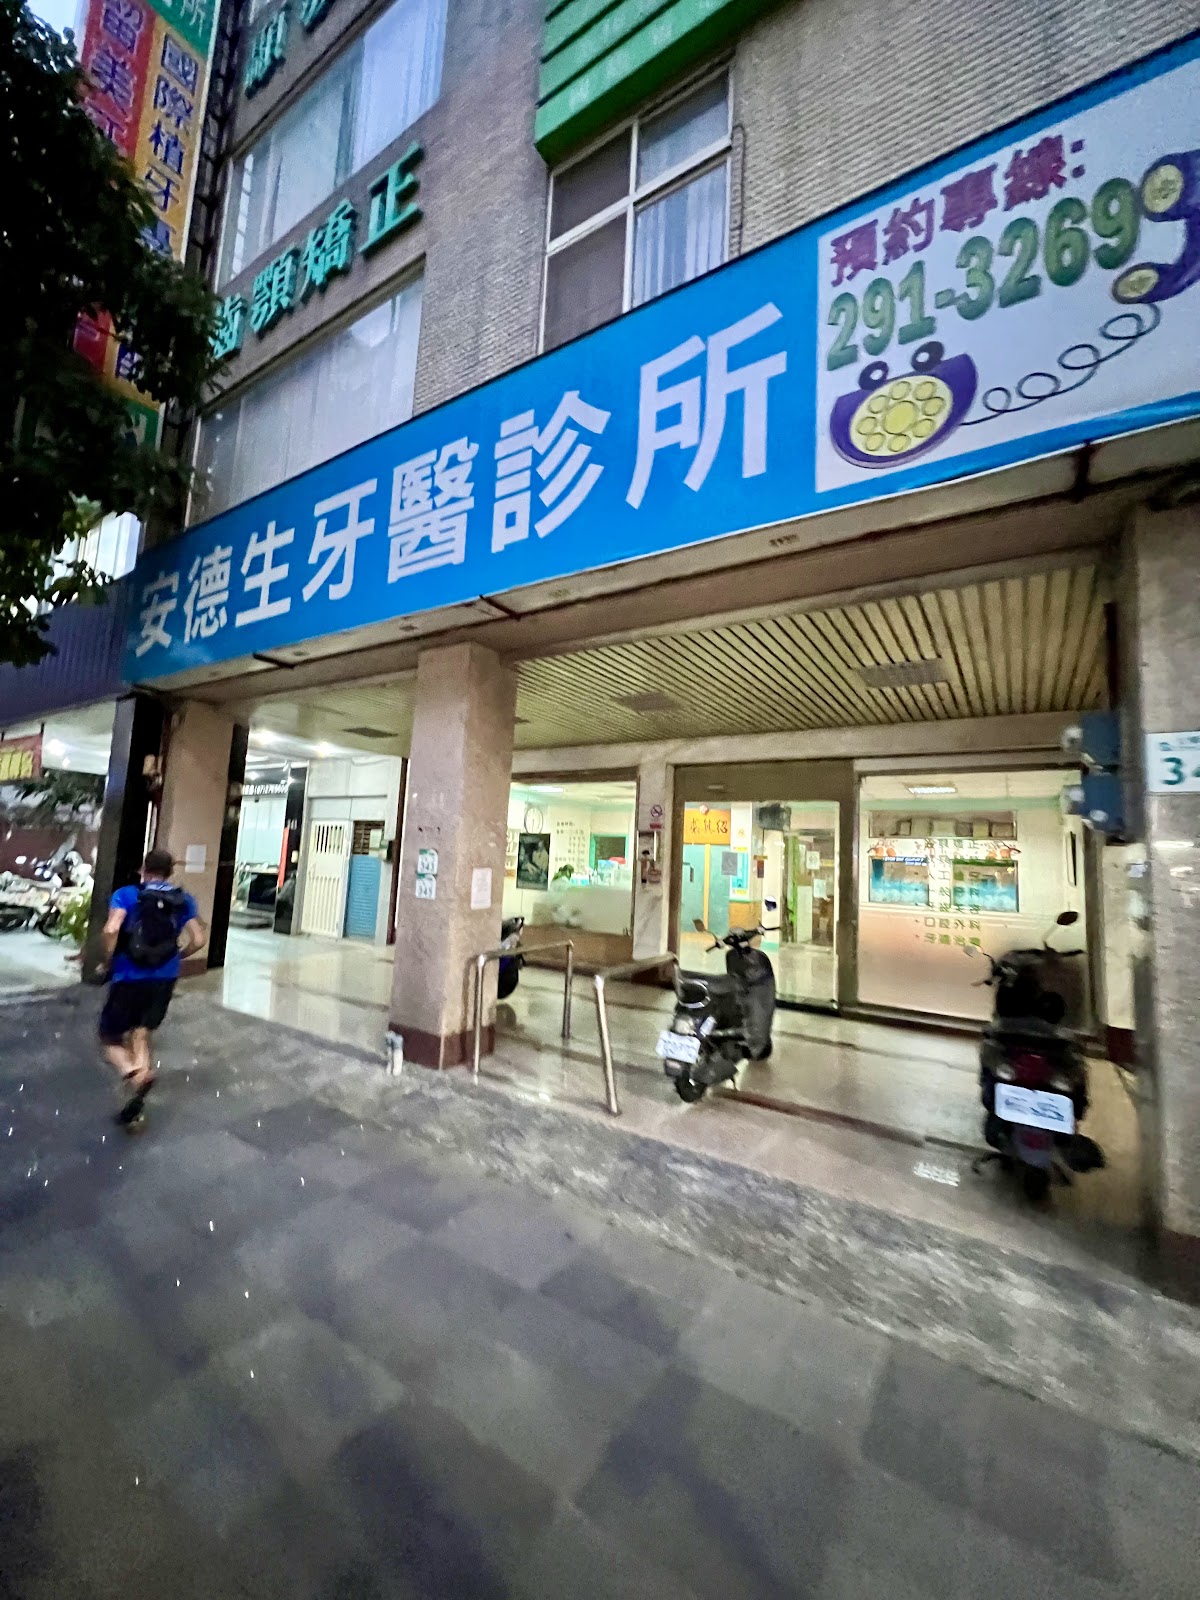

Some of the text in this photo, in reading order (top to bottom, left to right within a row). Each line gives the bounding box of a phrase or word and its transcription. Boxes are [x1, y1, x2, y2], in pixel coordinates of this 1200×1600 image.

[826, 177, 1141, 372] 291-3269
[830, 135, 1086, 288] 預約專線:
[134, 301, 789, 659] 安德生牙醫診所
